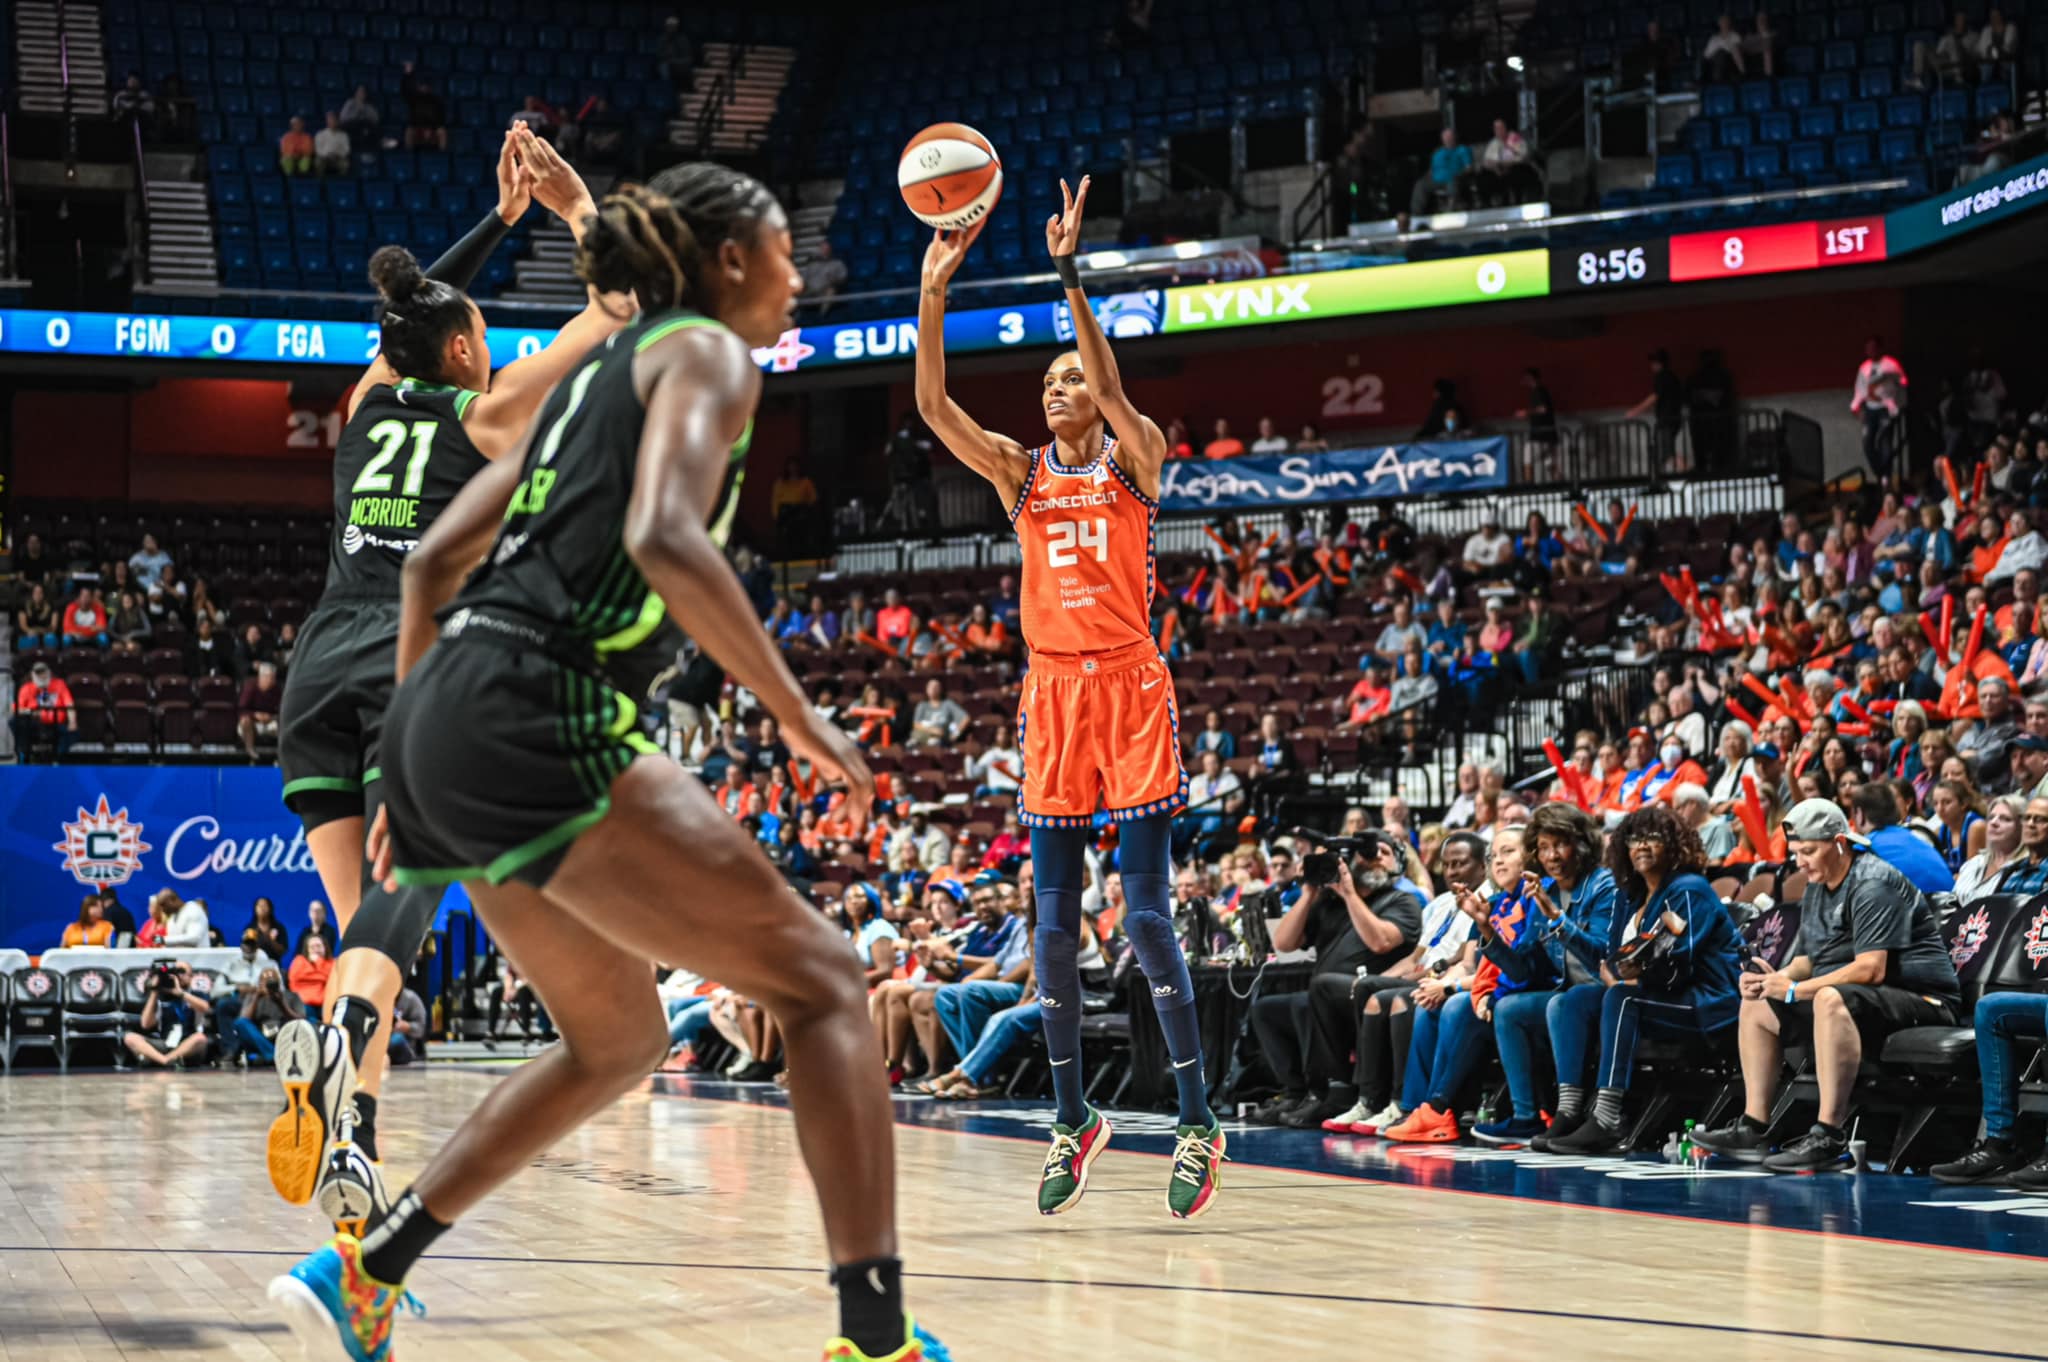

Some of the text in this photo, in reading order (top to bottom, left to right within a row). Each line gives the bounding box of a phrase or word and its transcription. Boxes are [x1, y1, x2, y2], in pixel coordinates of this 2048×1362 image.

[1723, 237, 1744, 269] 8
[1825, 226, 1869, 255] 1ST
[1577, 247, 1646, 285] 8:56
[1179, 261, 1506, 324] LYNX 0
[46, 318, 71, 348] 0
[116, 318, 170, 352] FGM
[211, 324, 236, 354] 0
[277, 324, 325, 358] FGA
[834, 312, 1024, 359] SUN 3
[1321, 374, 1383, 416] 22
[286, 410, 342, 447] 21
[351, 419, 438, 496] 21
[1276, 458, 1357, 499] Sun
[1364, 447, 1496, 492] Arena
[349, 497, 420, 528] MCBRIDE
[1031, 490, 1118, 513] CONNECTICUT
[1046, 518, 1107, 568] 24
[1058, 576, 1078, 586] Yale
[1062, 597, 1096, 609] Health
[86, 832, 118, 860] C
